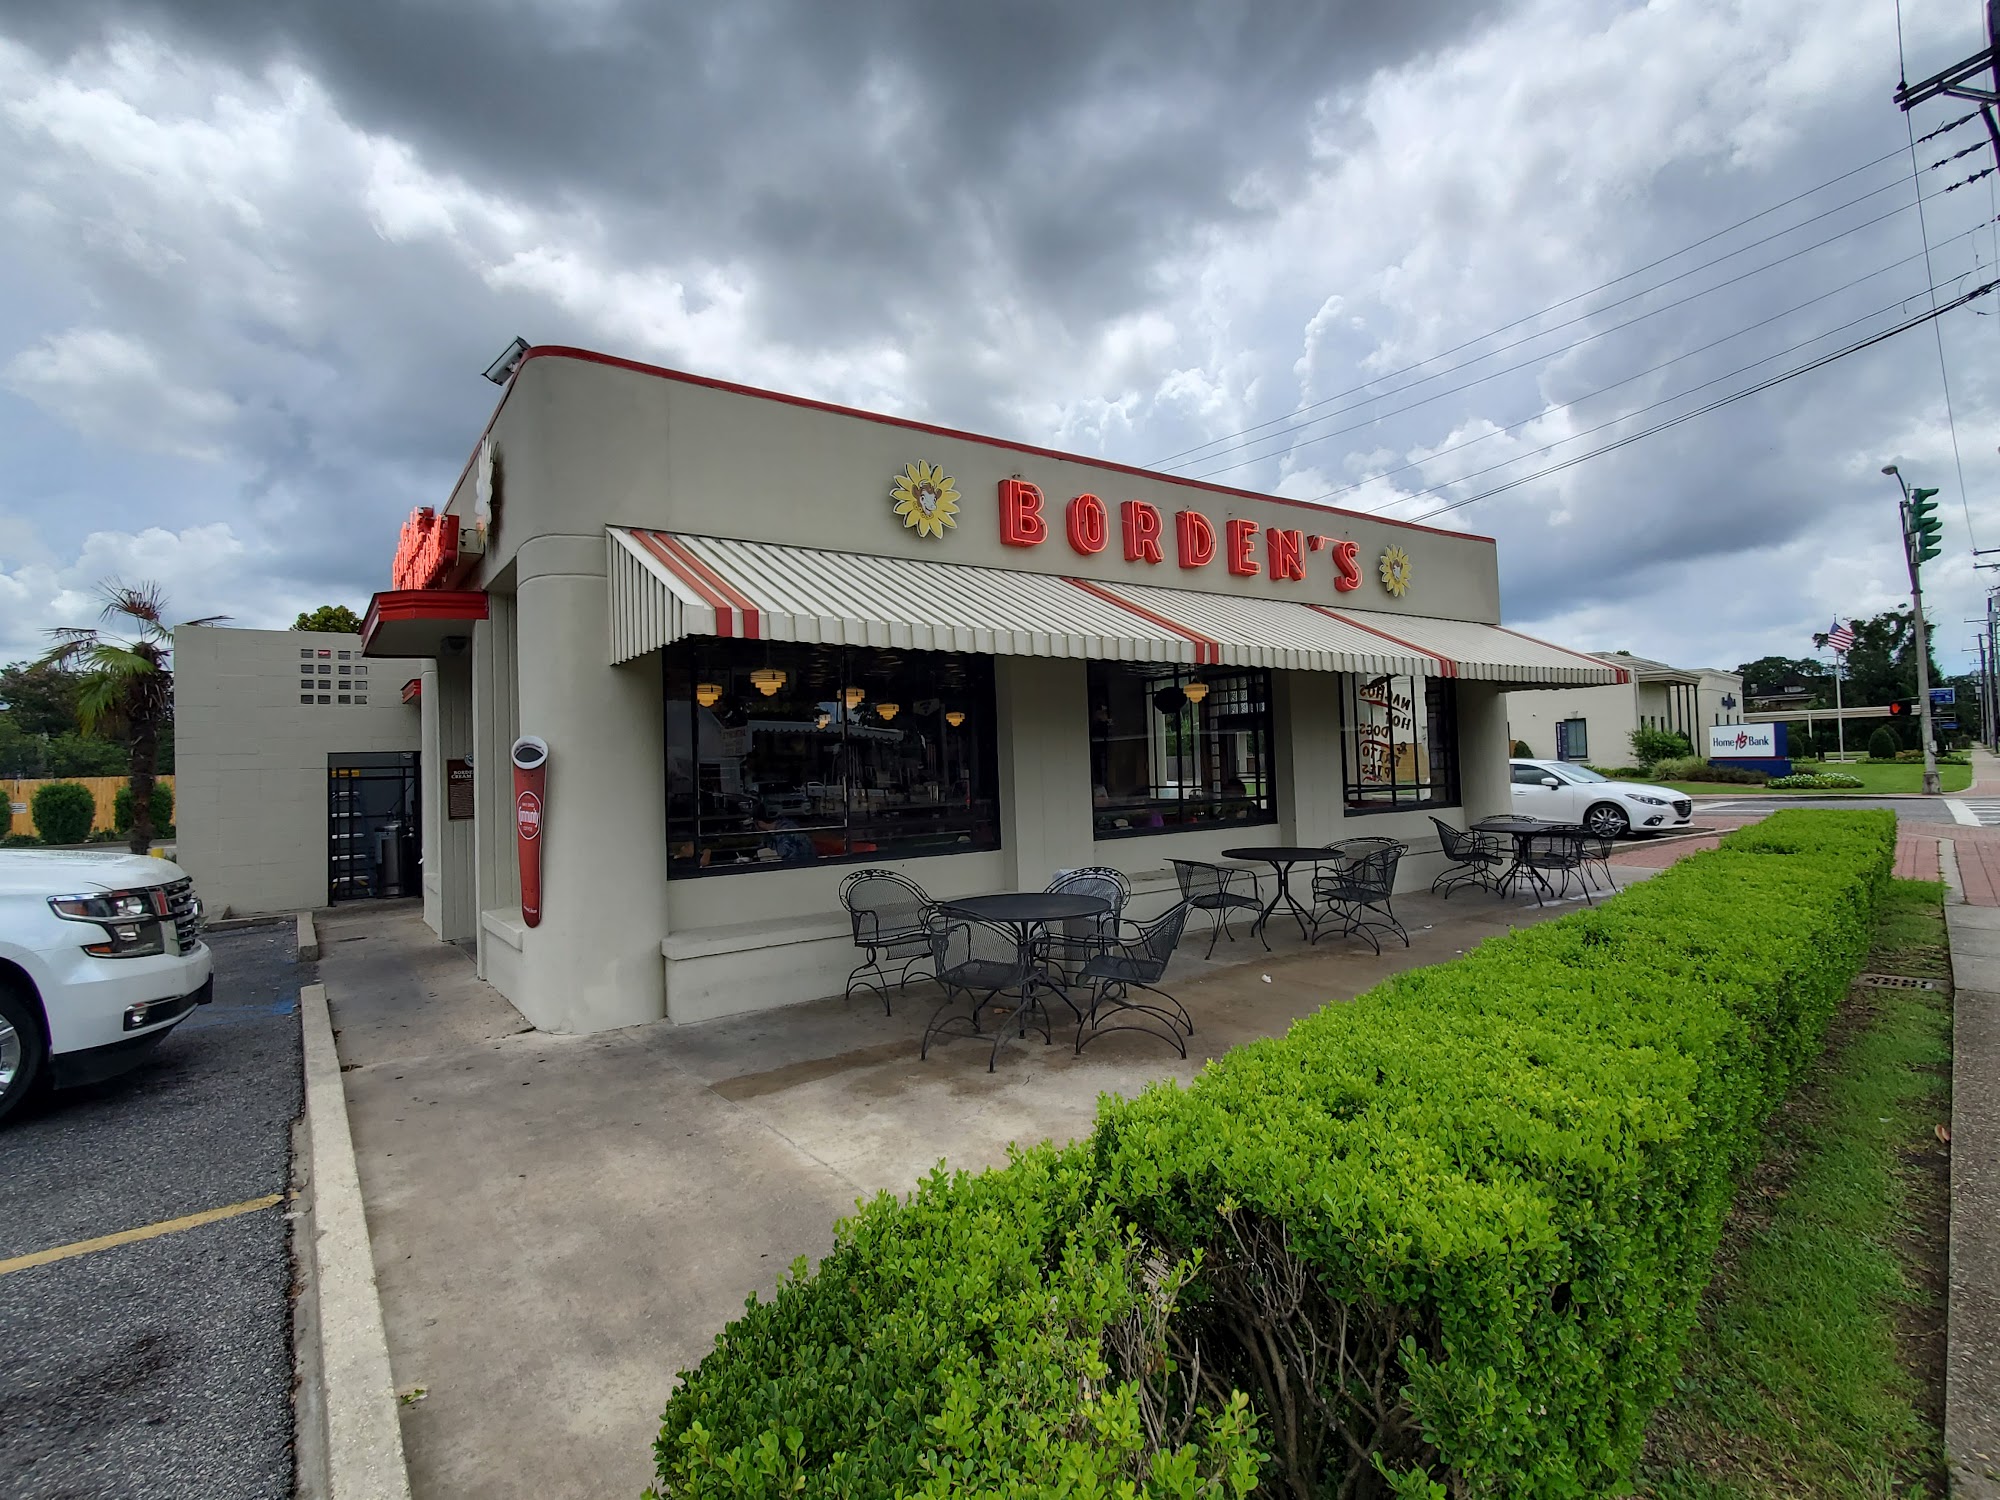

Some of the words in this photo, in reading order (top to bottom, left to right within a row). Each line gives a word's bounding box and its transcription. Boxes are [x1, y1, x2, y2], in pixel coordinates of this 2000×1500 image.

[998, 479, 1363, 592] BORDEN'S
[1713, 737, 1734, 747] Home
[1748, 736, 1769, 746] Bank
